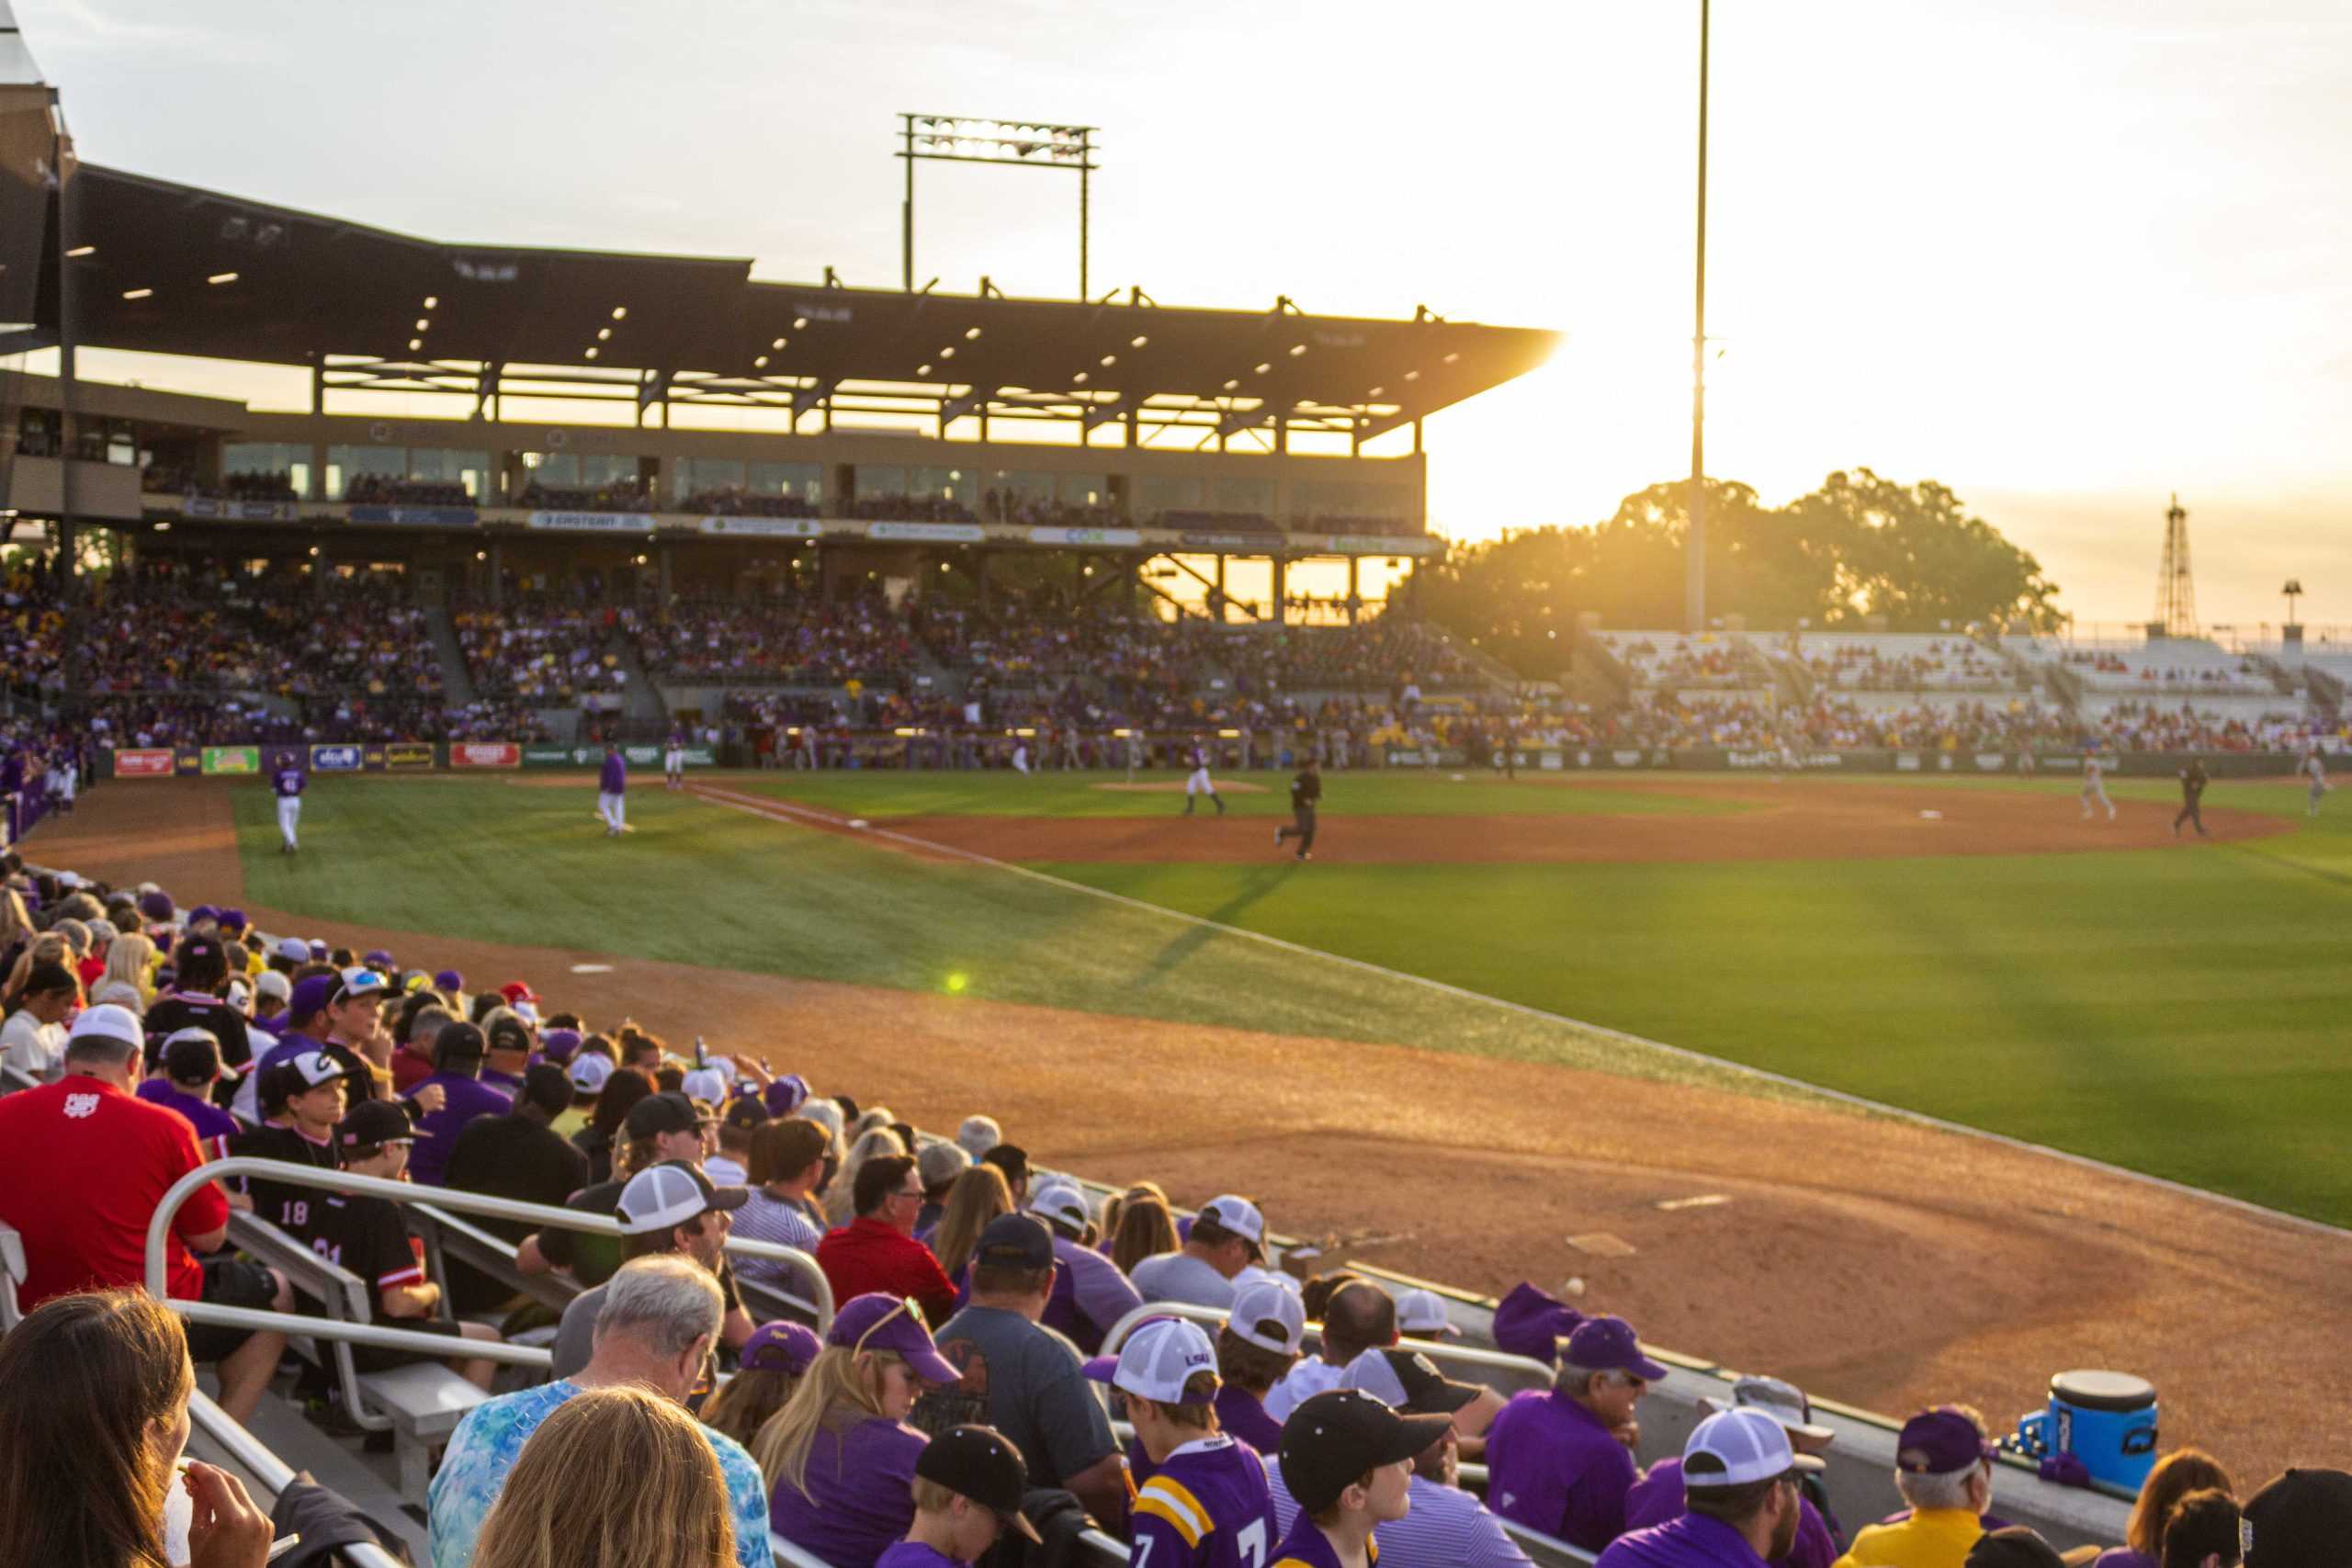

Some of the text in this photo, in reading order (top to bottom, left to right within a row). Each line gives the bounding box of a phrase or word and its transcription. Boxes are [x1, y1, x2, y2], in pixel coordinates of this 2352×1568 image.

[281, 1200, 308, 1224] 18
[1184, 1353, 1211, 1368] LSU
[1135, 1534, 1154, 1568] 7
[1237, 1517, 1266, 1568] 7
